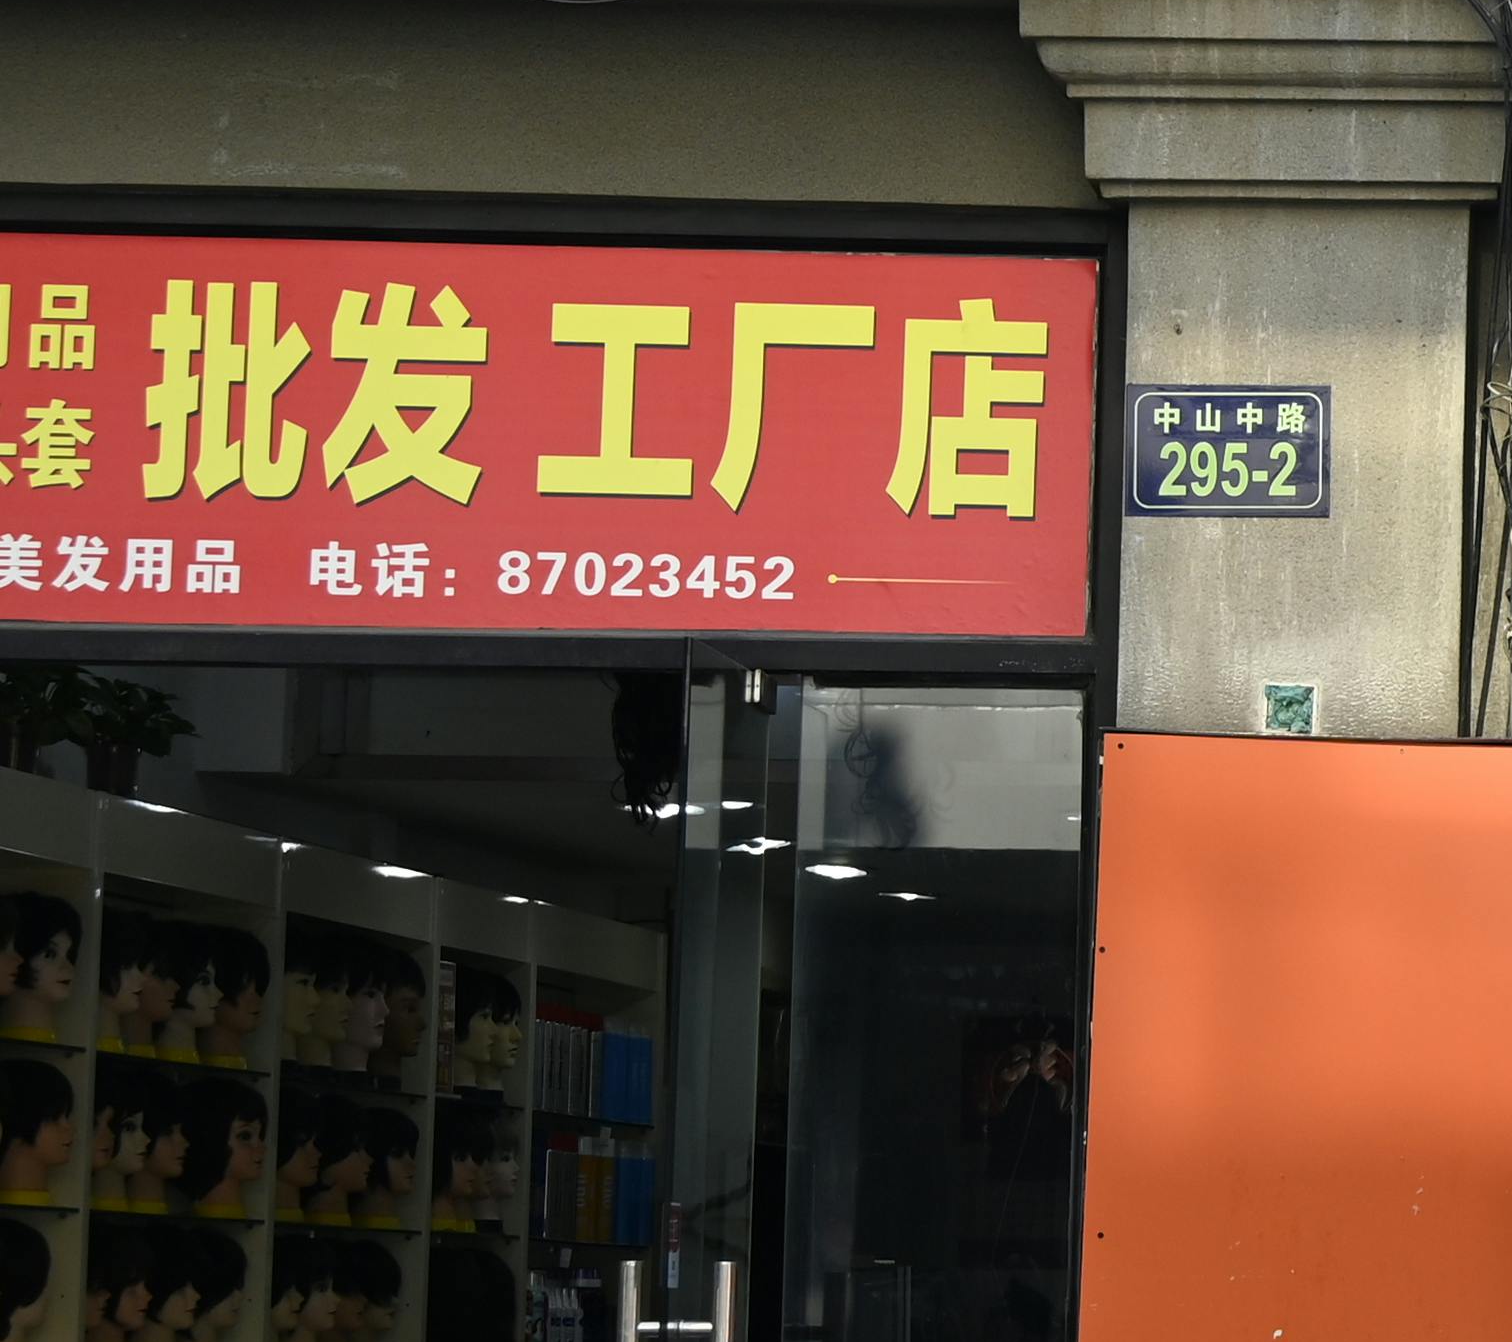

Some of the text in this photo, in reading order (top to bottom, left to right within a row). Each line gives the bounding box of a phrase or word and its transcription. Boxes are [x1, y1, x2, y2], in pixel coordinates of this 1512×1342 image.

[0, 284, 96, 370] 品
[1153, 400, 1307, 435] 中山中路
[1158, 440, 1298, 499] 295-2
